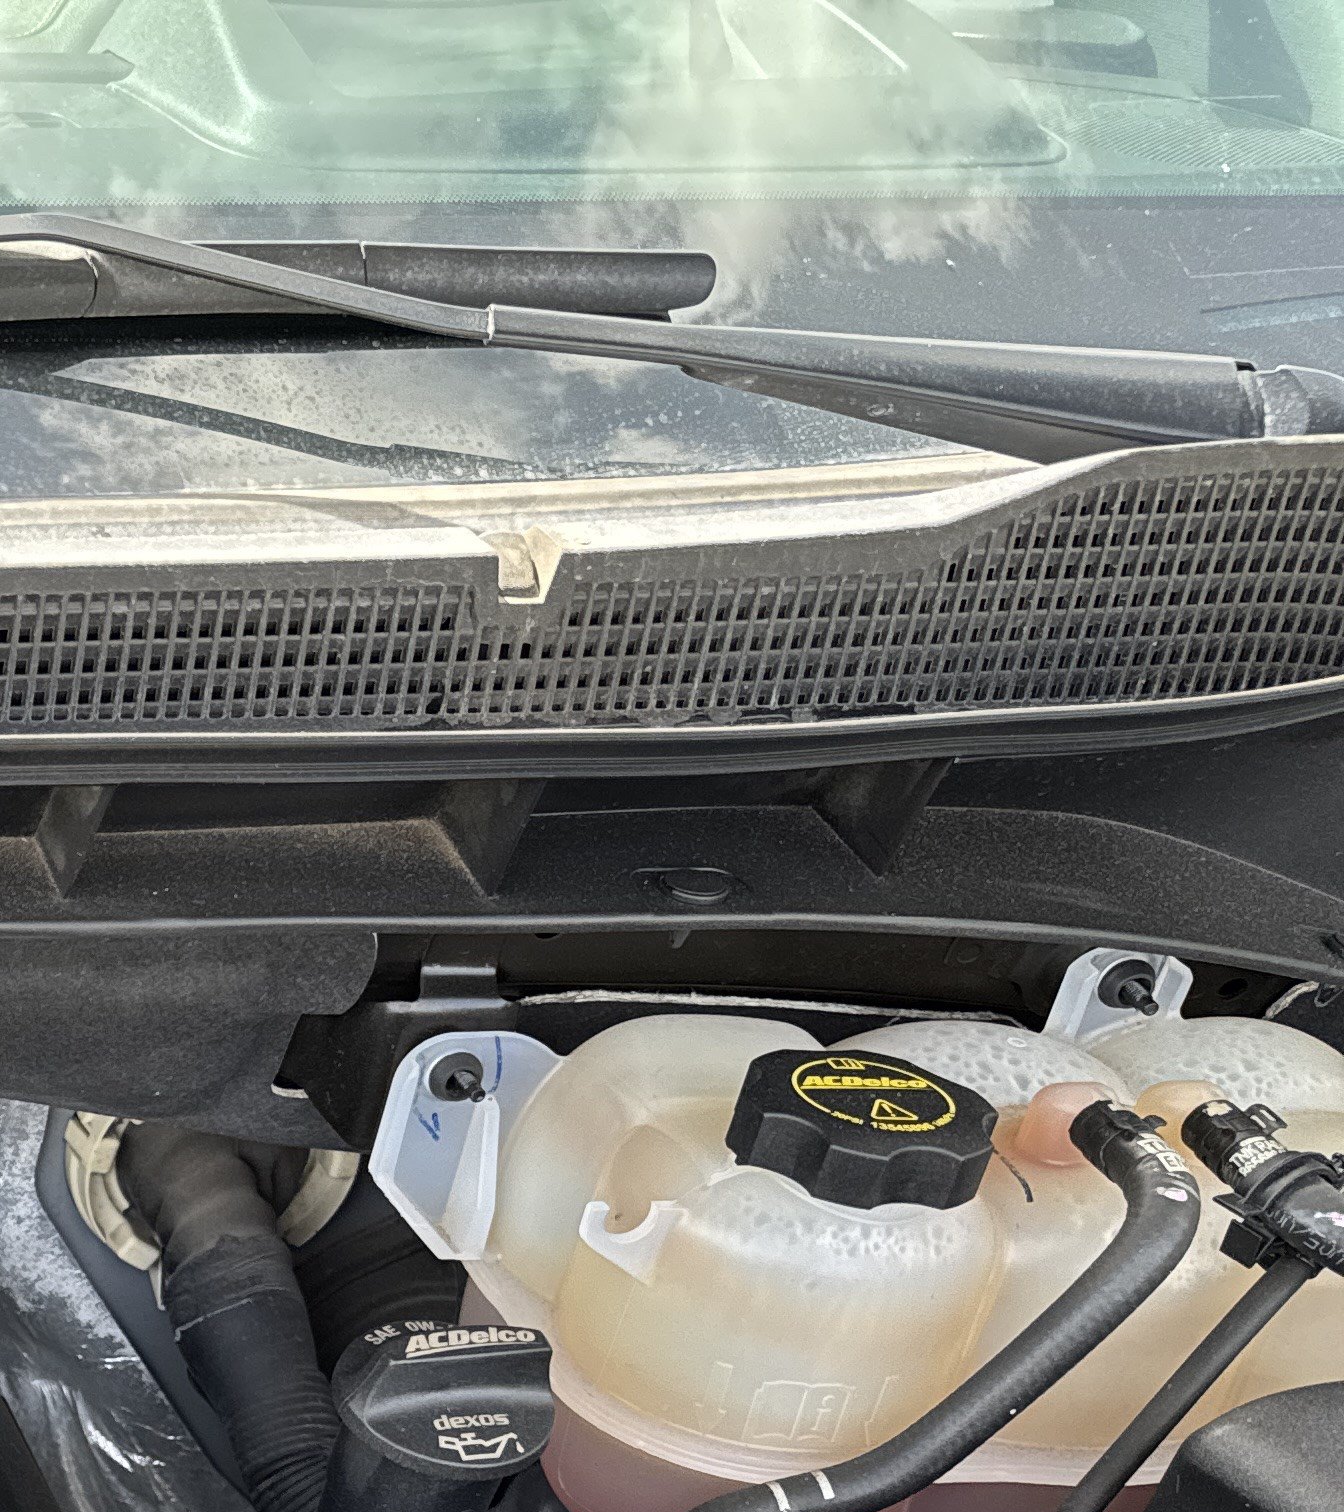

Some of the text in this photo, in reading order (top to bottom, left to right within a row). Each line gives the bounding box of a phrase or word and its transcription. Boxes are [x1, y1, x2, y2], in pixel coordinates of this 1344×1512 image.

[801, 1075, 929, 1089] ACDelco
[1229, 1142, 1258, 1167] TNK
[364, 1320, 454, 1346] SAE 0W-
[405, 1327, 536, 1354] ACDelco
[433, 1413, 510, 1431] dexos
